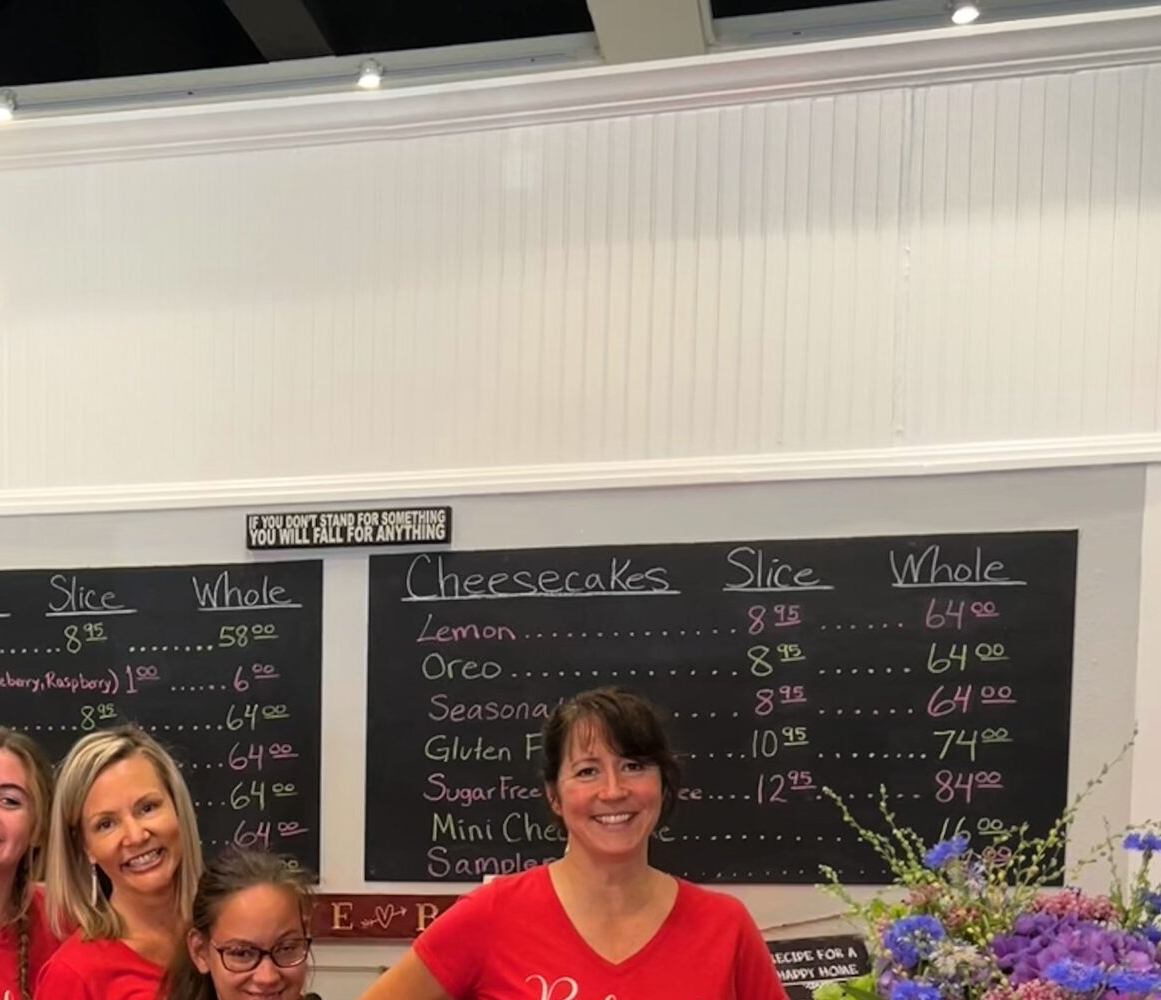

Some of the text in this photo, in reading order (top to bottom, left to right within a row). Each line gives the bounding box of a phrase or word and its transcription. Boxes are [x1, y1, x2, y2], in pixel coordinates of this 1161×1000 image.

[249, 509, 446, 529] IF YOU DON'T STAND FOR SOMETHING
[249, 523, 445, 546] YOU WILL FALL FOR ANYTHING
[725, 547, 820, 588] Slice
[890, 545, 1010, 584] Whole
[48, 574, 125, 612] Slice
[192, 571, 293, 608] Whole
[416, 613, 516, 643] Lemon
[422, 652, 502, 680] Oreo
[428, 694, 561, 722] Seasona
[424, 734, 511, 762] Gluten
[423, 773, 495, 807] Sugar
[499, 776, 542, 800] Free
[431, 813, 492, 842] Mini
[817, 948, 845, 960] FOR
[848, 947, 858, 958] A
[819, 964, 859, 977] HOME
